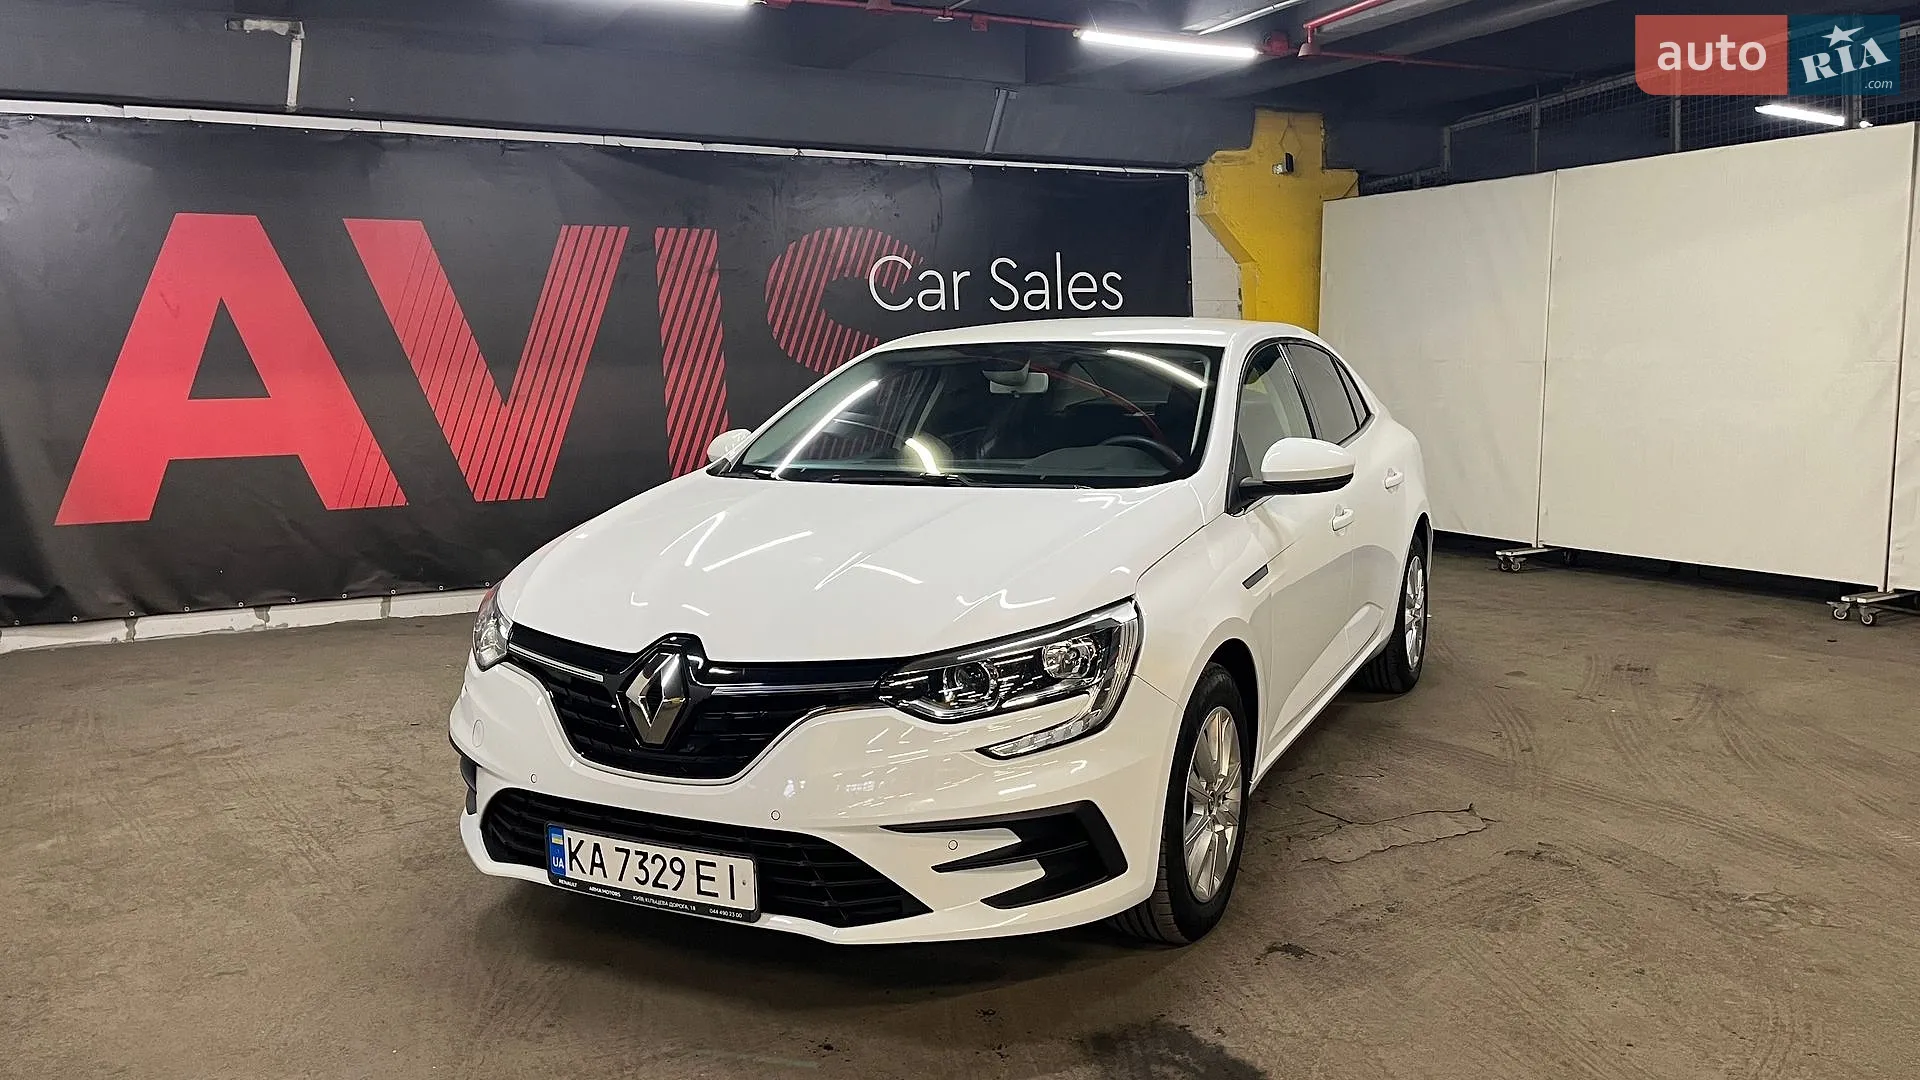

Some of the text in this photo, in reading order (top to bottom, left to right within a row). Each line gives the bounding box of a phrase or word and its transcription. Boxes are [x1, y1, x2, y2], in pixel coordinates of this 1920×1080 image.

[868, 251, 1124, 312] Car Sales
[552, 855, 565, 869] UA
[567, 836, 608, 879] KA
[614, 846, 687, 892] 7329
[558, 878, 578, 888] RENAULT
